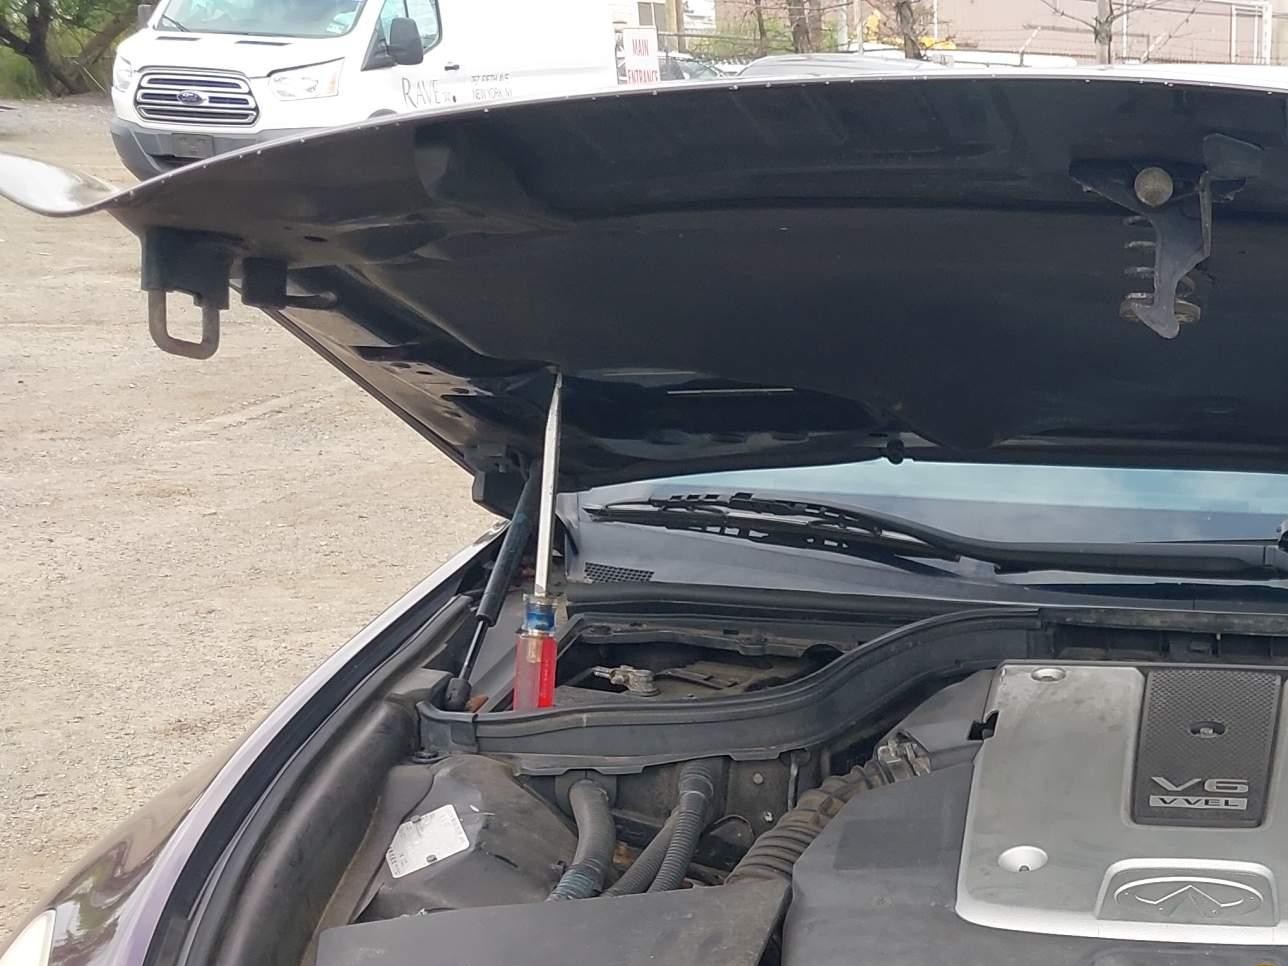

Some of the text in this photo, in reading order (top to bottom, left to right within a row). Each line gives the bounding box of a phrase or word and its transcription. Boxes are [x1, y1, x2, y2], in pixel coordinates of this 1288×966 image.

[632, 39, 649, 57] MAIN
[627, 69, 658, 86] ENTRANCE
[401, 77, 441, 108] RAVE
[1151, 776, 1249, 793] V6
[1159, 796, 1241, 808] VVEL
